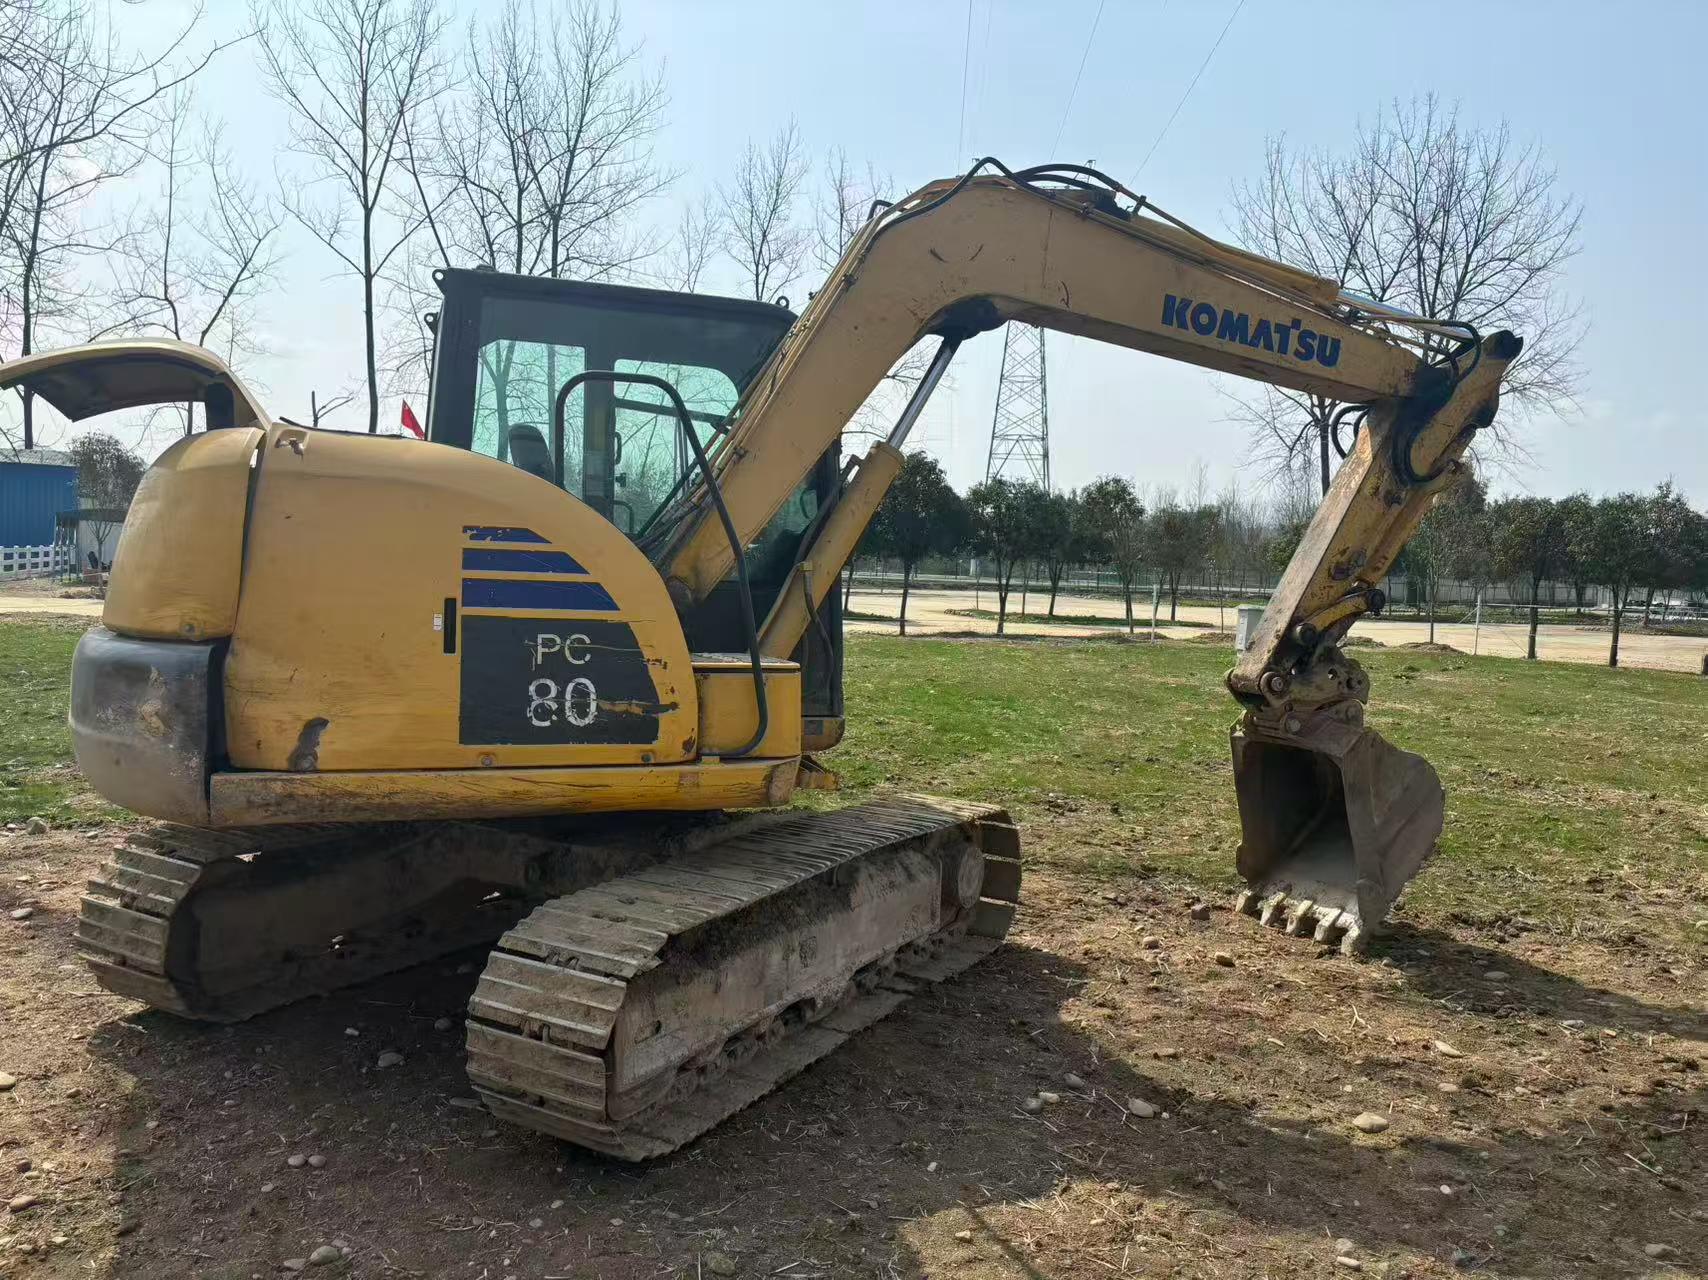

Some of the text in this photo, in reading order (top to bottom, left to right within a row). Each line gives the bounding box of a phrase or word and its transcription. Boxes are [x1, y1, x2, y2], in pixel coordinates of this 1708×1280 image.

[1161, 293, 1342, 368] KOMATSU
[535, 633, 592, 665] PC
[527, 677, 597, 727] 80
